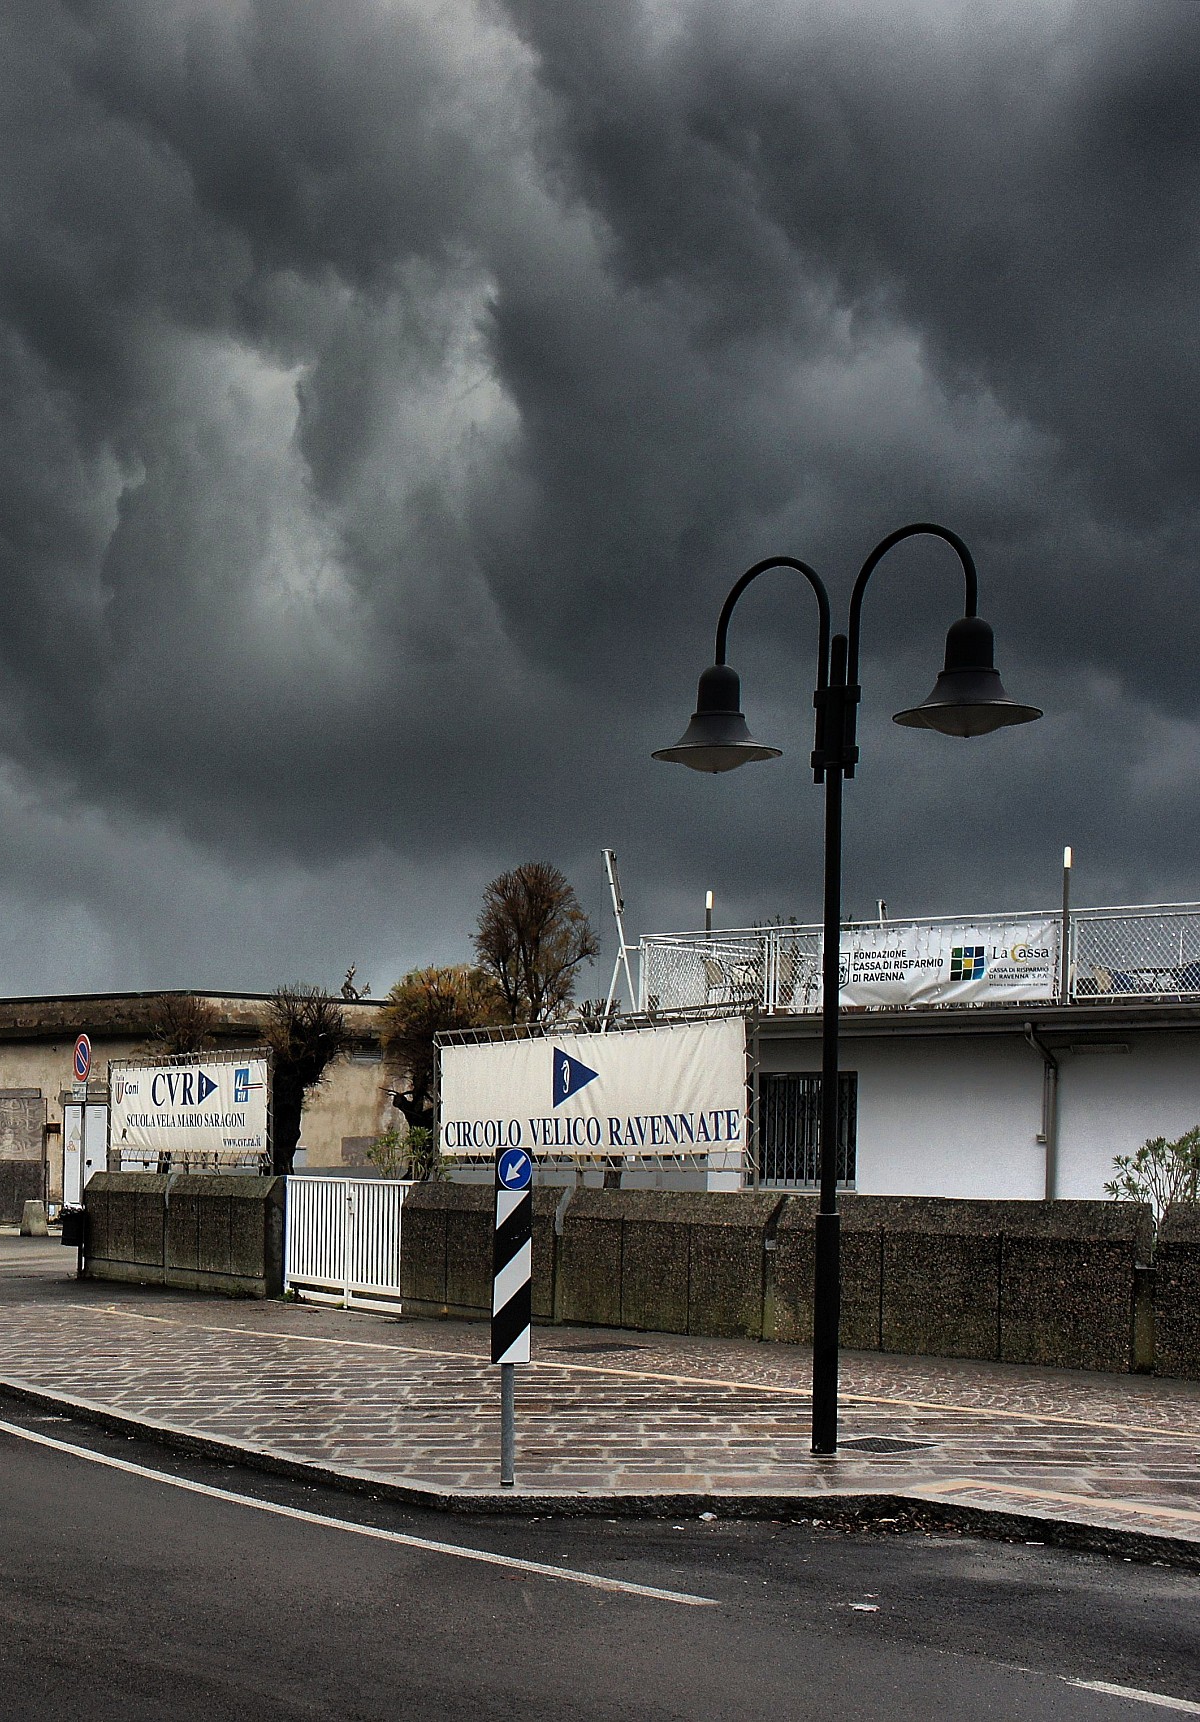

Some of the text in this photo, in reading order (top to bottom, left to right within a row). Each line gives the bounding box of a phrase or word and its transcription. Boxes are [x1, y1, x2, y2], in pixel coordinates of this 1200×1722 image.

[853, 950, 907, 960] FONDAZIONE
[992, 943, 1049, 963] La Cassa
[853, 958, 944, 971] CASSA DI RISPARMIO
[853, 971, 905, 982] DI RAVENNA
[124, 1081, 139, 1095] Coni
[151, 1072, 195, 1107] CVR
[126, 1112, 245, 1128] SCUOLA VELA MARIO SARAGONI
[444, 1109, 740, 1148] CIRCOLO VELICO RAVENNATE
